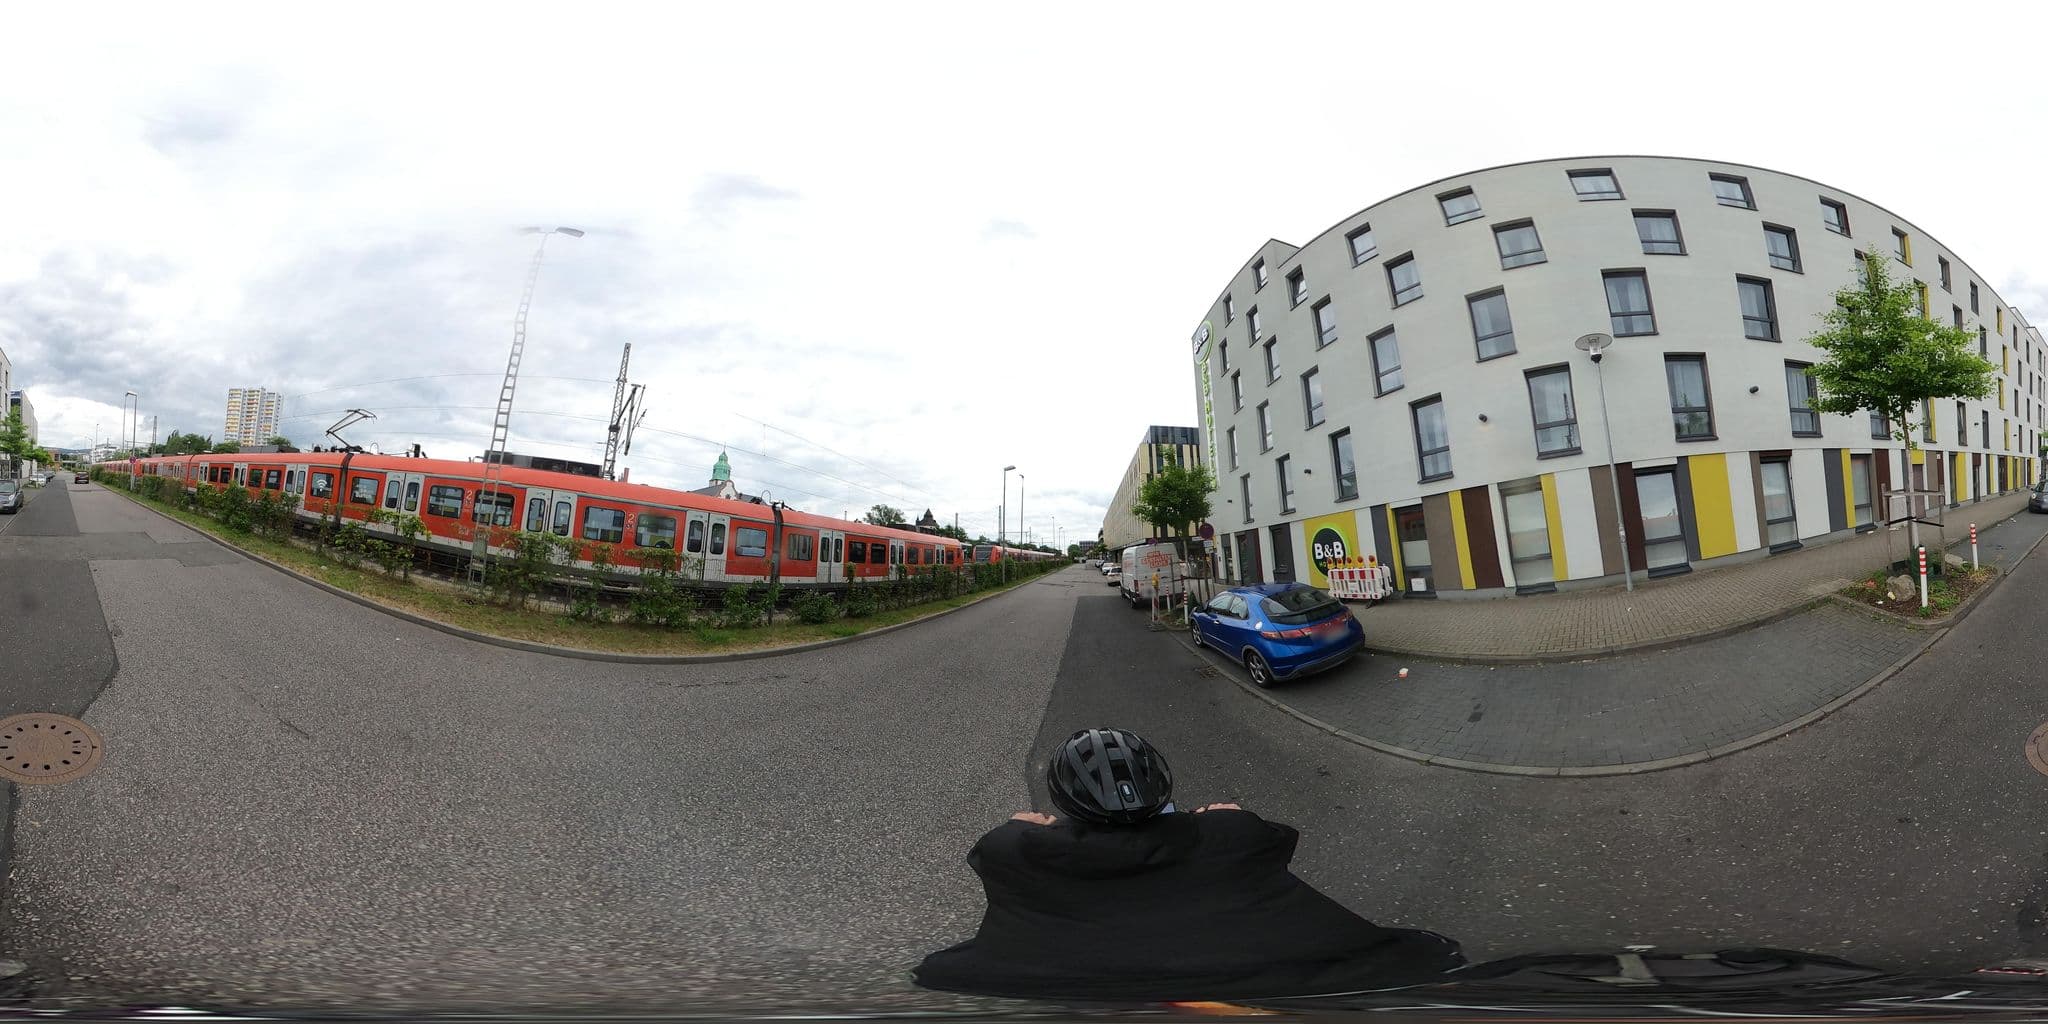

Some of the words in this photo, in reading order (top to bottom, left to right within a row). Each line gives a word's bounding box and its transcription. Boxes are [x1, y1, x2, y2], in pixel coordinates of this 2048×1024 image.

[1193, 329, 1209, 354] B&B
[466, 490, 473, 499] 2
[628, 513, 635, 523] 2
[1314, 541, 1344, 560] B&B
